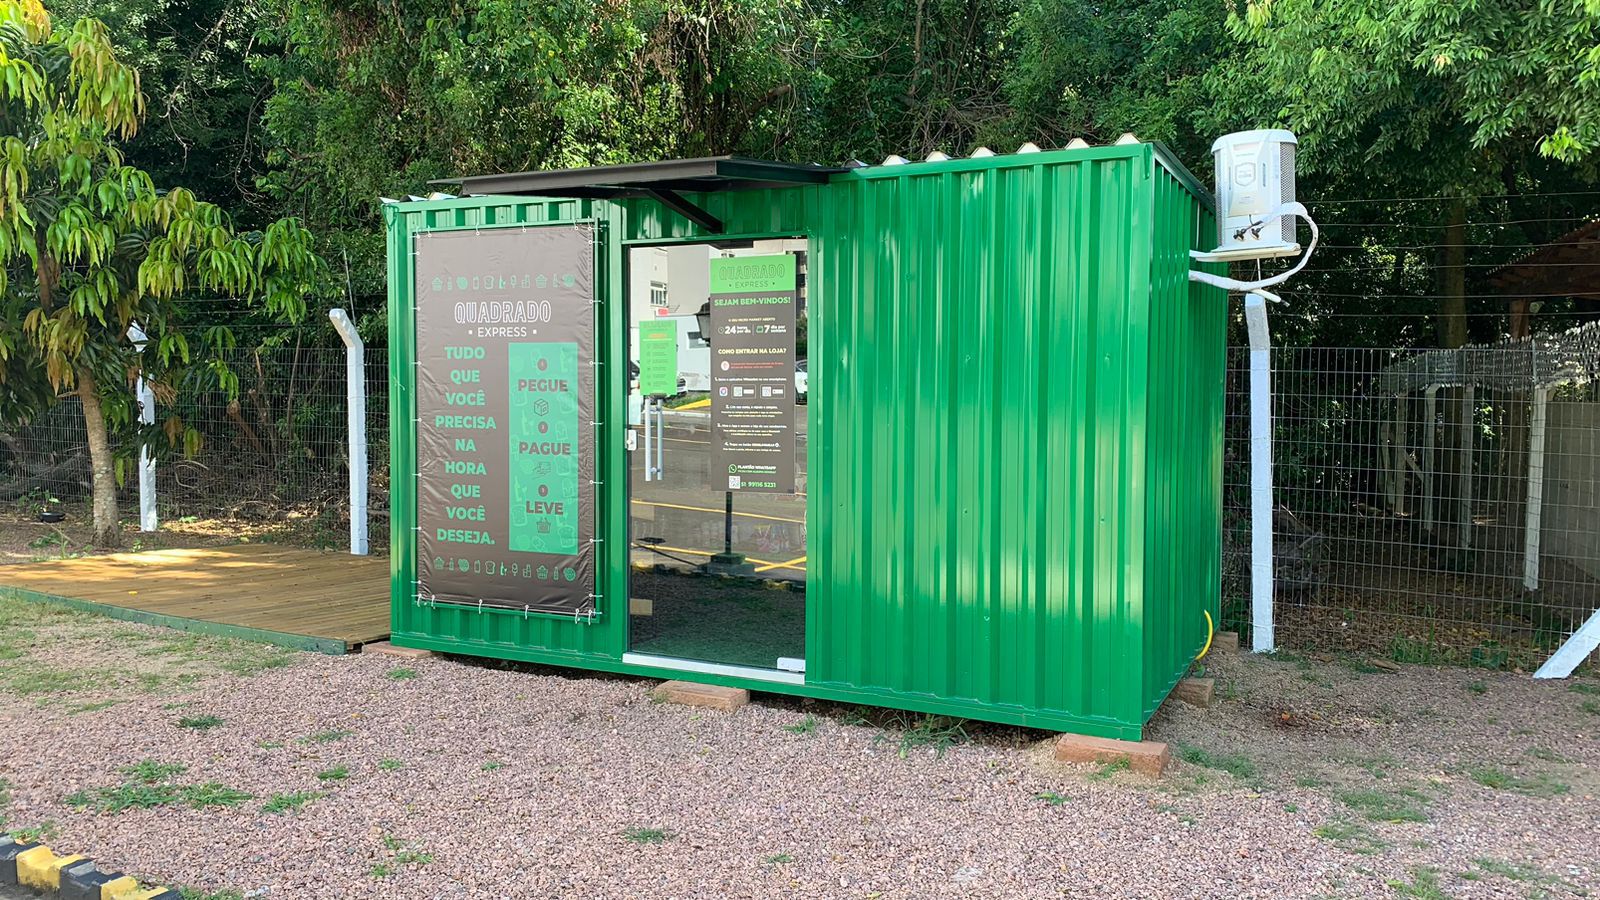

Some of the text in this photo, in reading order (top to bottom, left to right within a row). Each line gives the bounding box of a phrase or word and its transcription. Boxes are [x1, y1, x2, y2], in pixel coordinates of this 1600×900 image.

[719, 263, 786, 281] QUADRADO
[714, 297, 791, 306] SEJAM BEM-VINDOS!
[454, 300, 552, 324] QUADRADO
[477, 327, 527, 337] EXPRESS
[724, 324, 770, 335] 24 7
[444, 346, 485, 360] TUDO
[450, 370, 480, 384] QUE
[518, 379, 568, 392] PEGUE
[445, 390, 486, 406] VOCÊ
[435, 415, 497, 429] PRECISA
[455, 439, 476, 451] NA
[519, 442, 571, 456] PAGUE
[444, 461, 487, 475] HORA
[450, 484, 480, 499] QUE
[445, 505, 486, 521] VOCÊ
[525, 501, 563, 515] LEVE
[436, 528, 495, 544] DESEJA.
